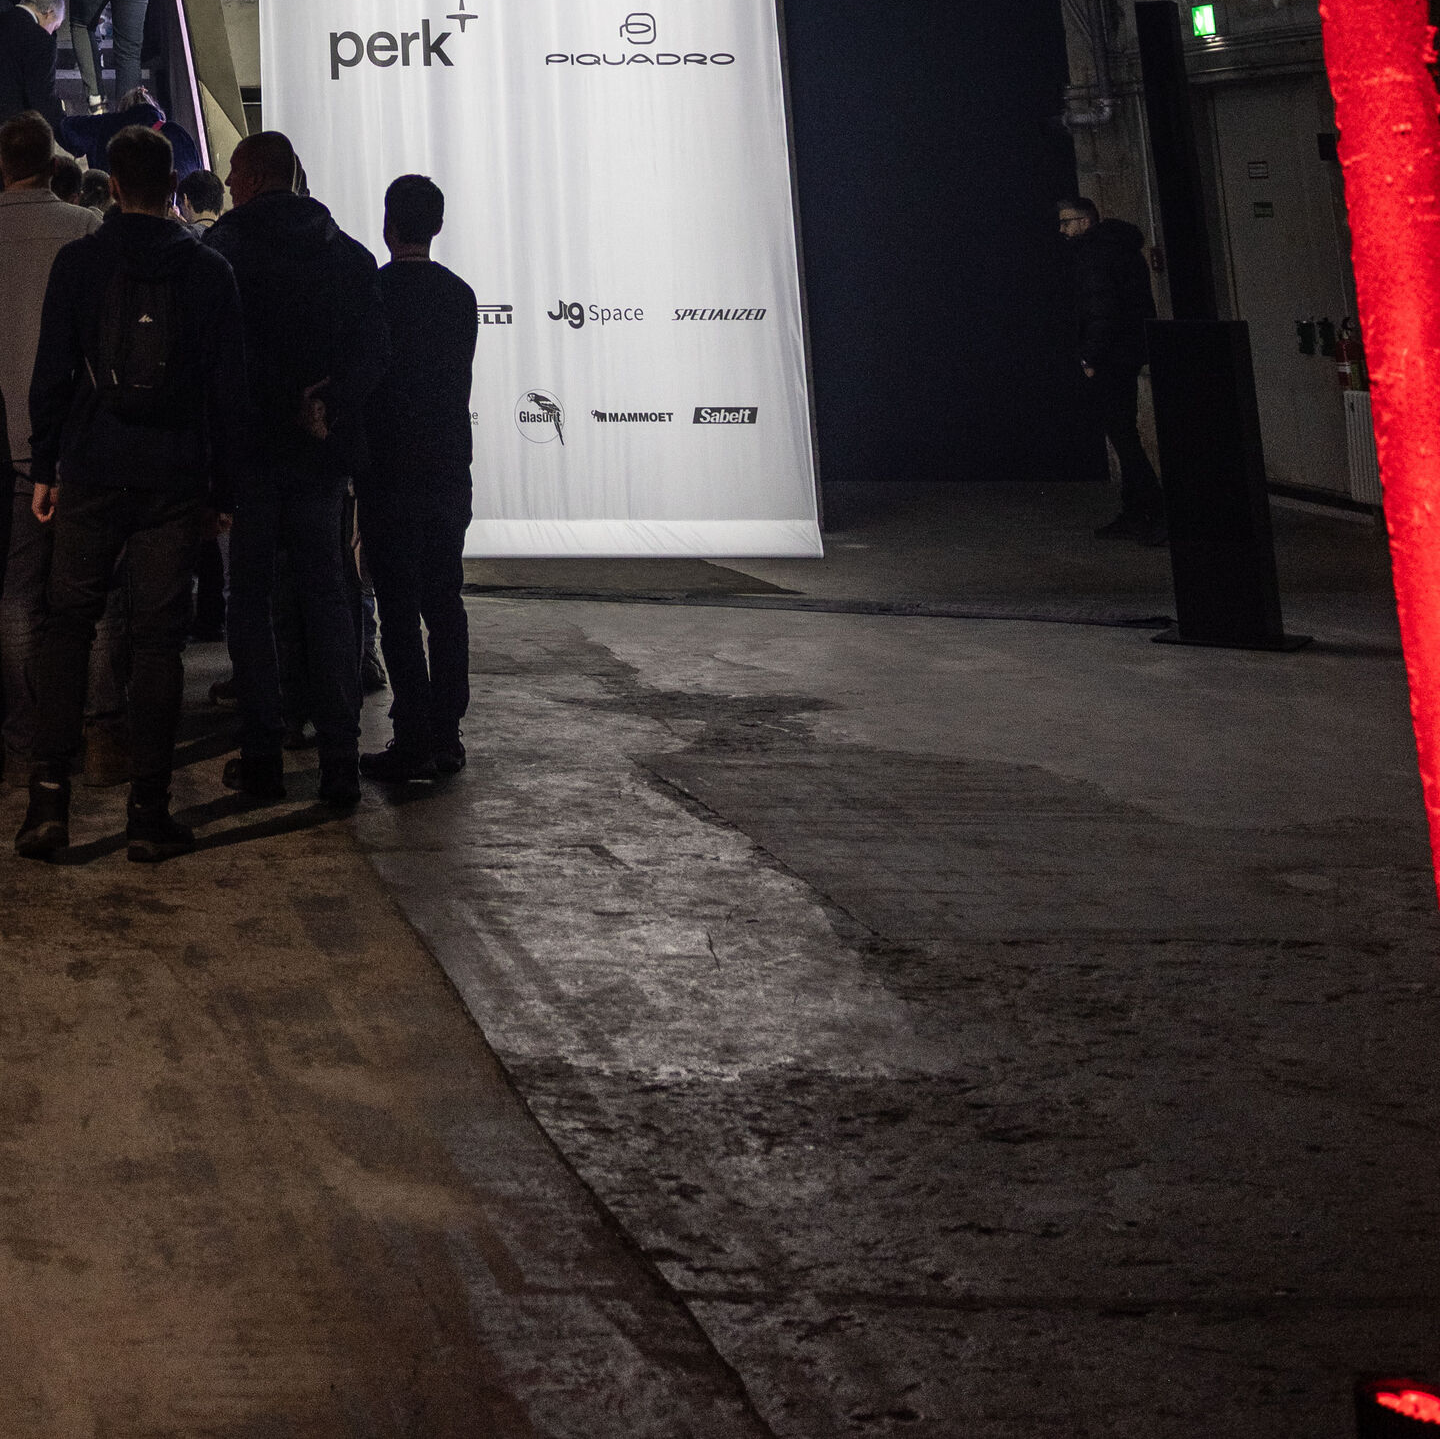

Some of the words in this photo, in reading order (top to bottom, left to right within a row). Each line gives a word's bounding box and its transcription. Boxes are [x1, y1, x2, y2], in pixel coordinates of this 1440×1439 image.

[545, 52, 736, 66] PIQUADRO
[671, 308, 767, 321] SPECIALIZED
[608, 412, 674, 423] MAMMOET
[699, 408, 752, 424] Sabelt
